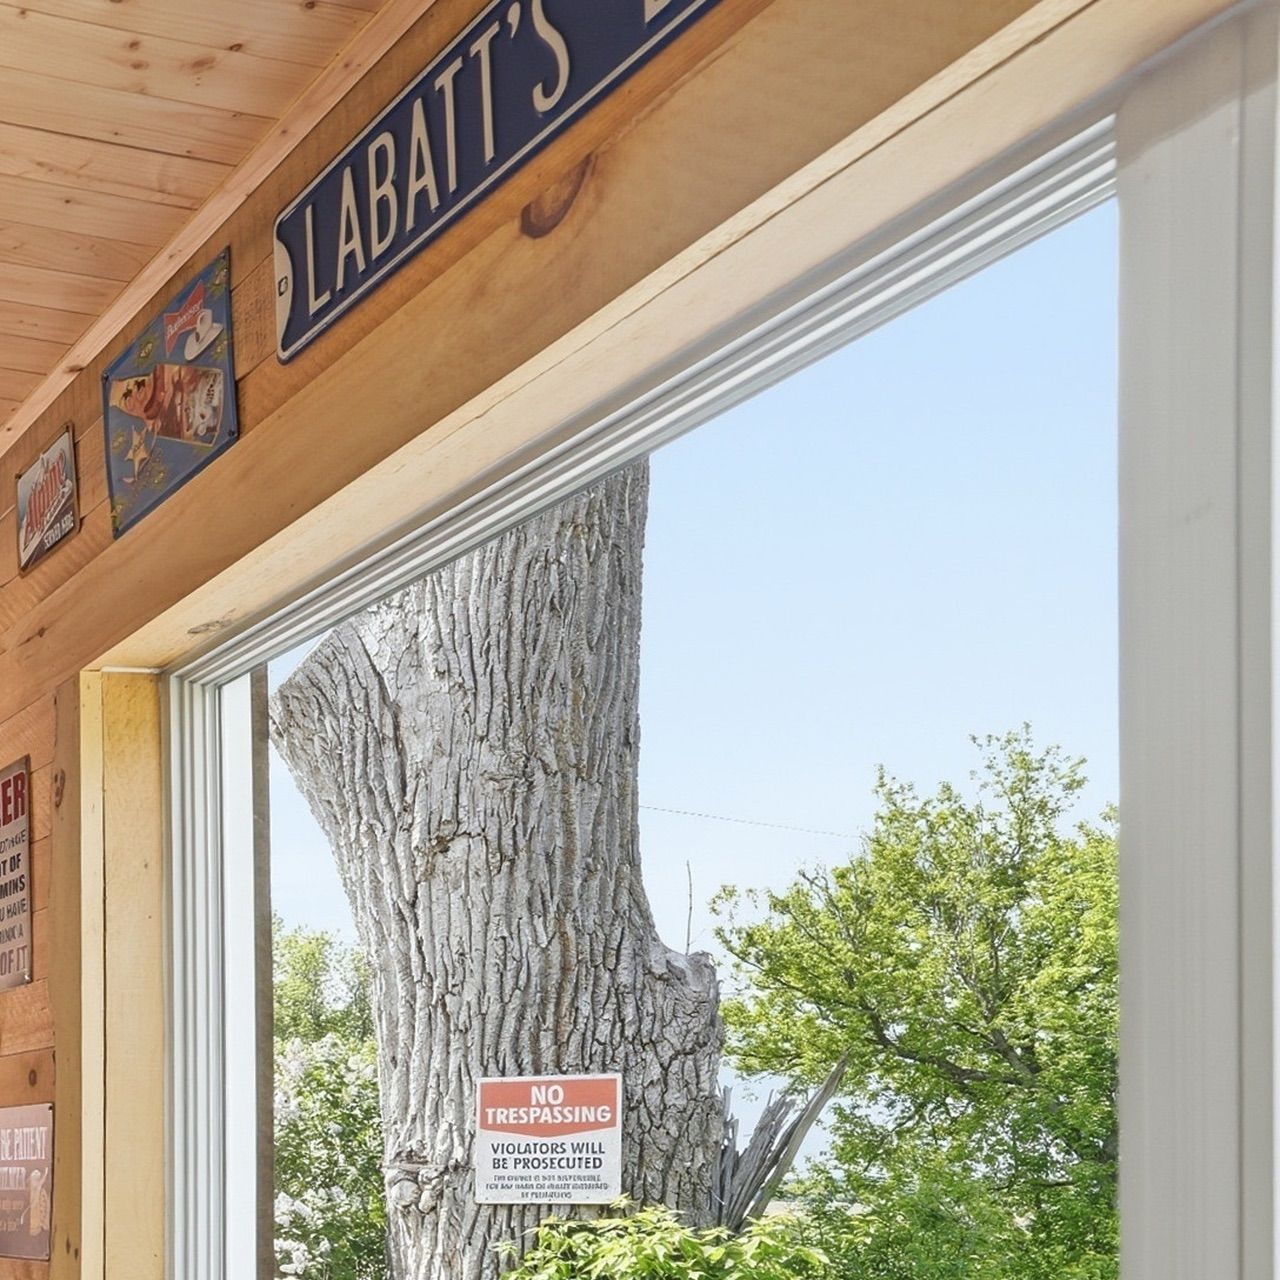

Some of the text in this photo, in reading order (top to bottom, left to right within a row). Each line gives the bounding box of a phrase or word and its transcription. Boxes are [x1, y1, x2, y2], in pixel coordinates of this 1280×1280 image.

[305, 0, 570, 318] LABATT'S
[10, 853, 22, 876] OF
[6, 899, 27, 923] HAVE
[15, 943, 28, 972] IT
[531, 1085, 564, 1105] NO
[485, 1105, 612, 1125] TRESPASSING
[14, 1126, 48, 1161] PATIENT
[491, 1142, 606, 1155] VIOLATORS WILL
[492, 1157, 603, 1170] BE PROSECUTED
